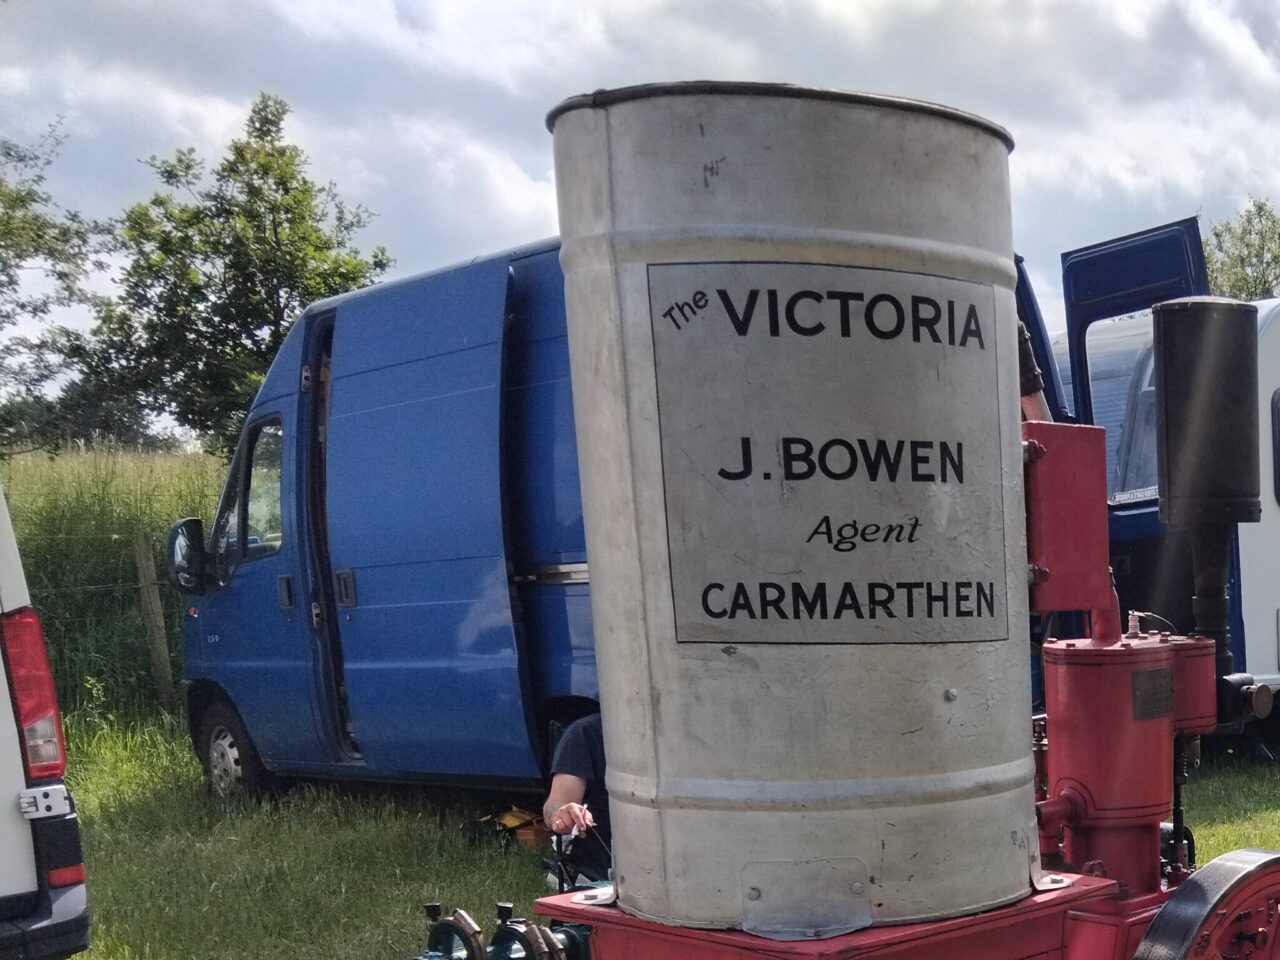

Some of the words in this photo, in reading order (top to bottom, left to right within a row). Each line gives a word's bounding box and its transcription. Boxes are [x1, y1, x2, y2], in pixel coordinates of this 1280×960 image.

[662, 289, 709, 331] The
[716, 288, 985, 351] VICTORIA
[806, 515, 923, 552] Agent
[701, 581, 995, 620] CARMARTHEN
